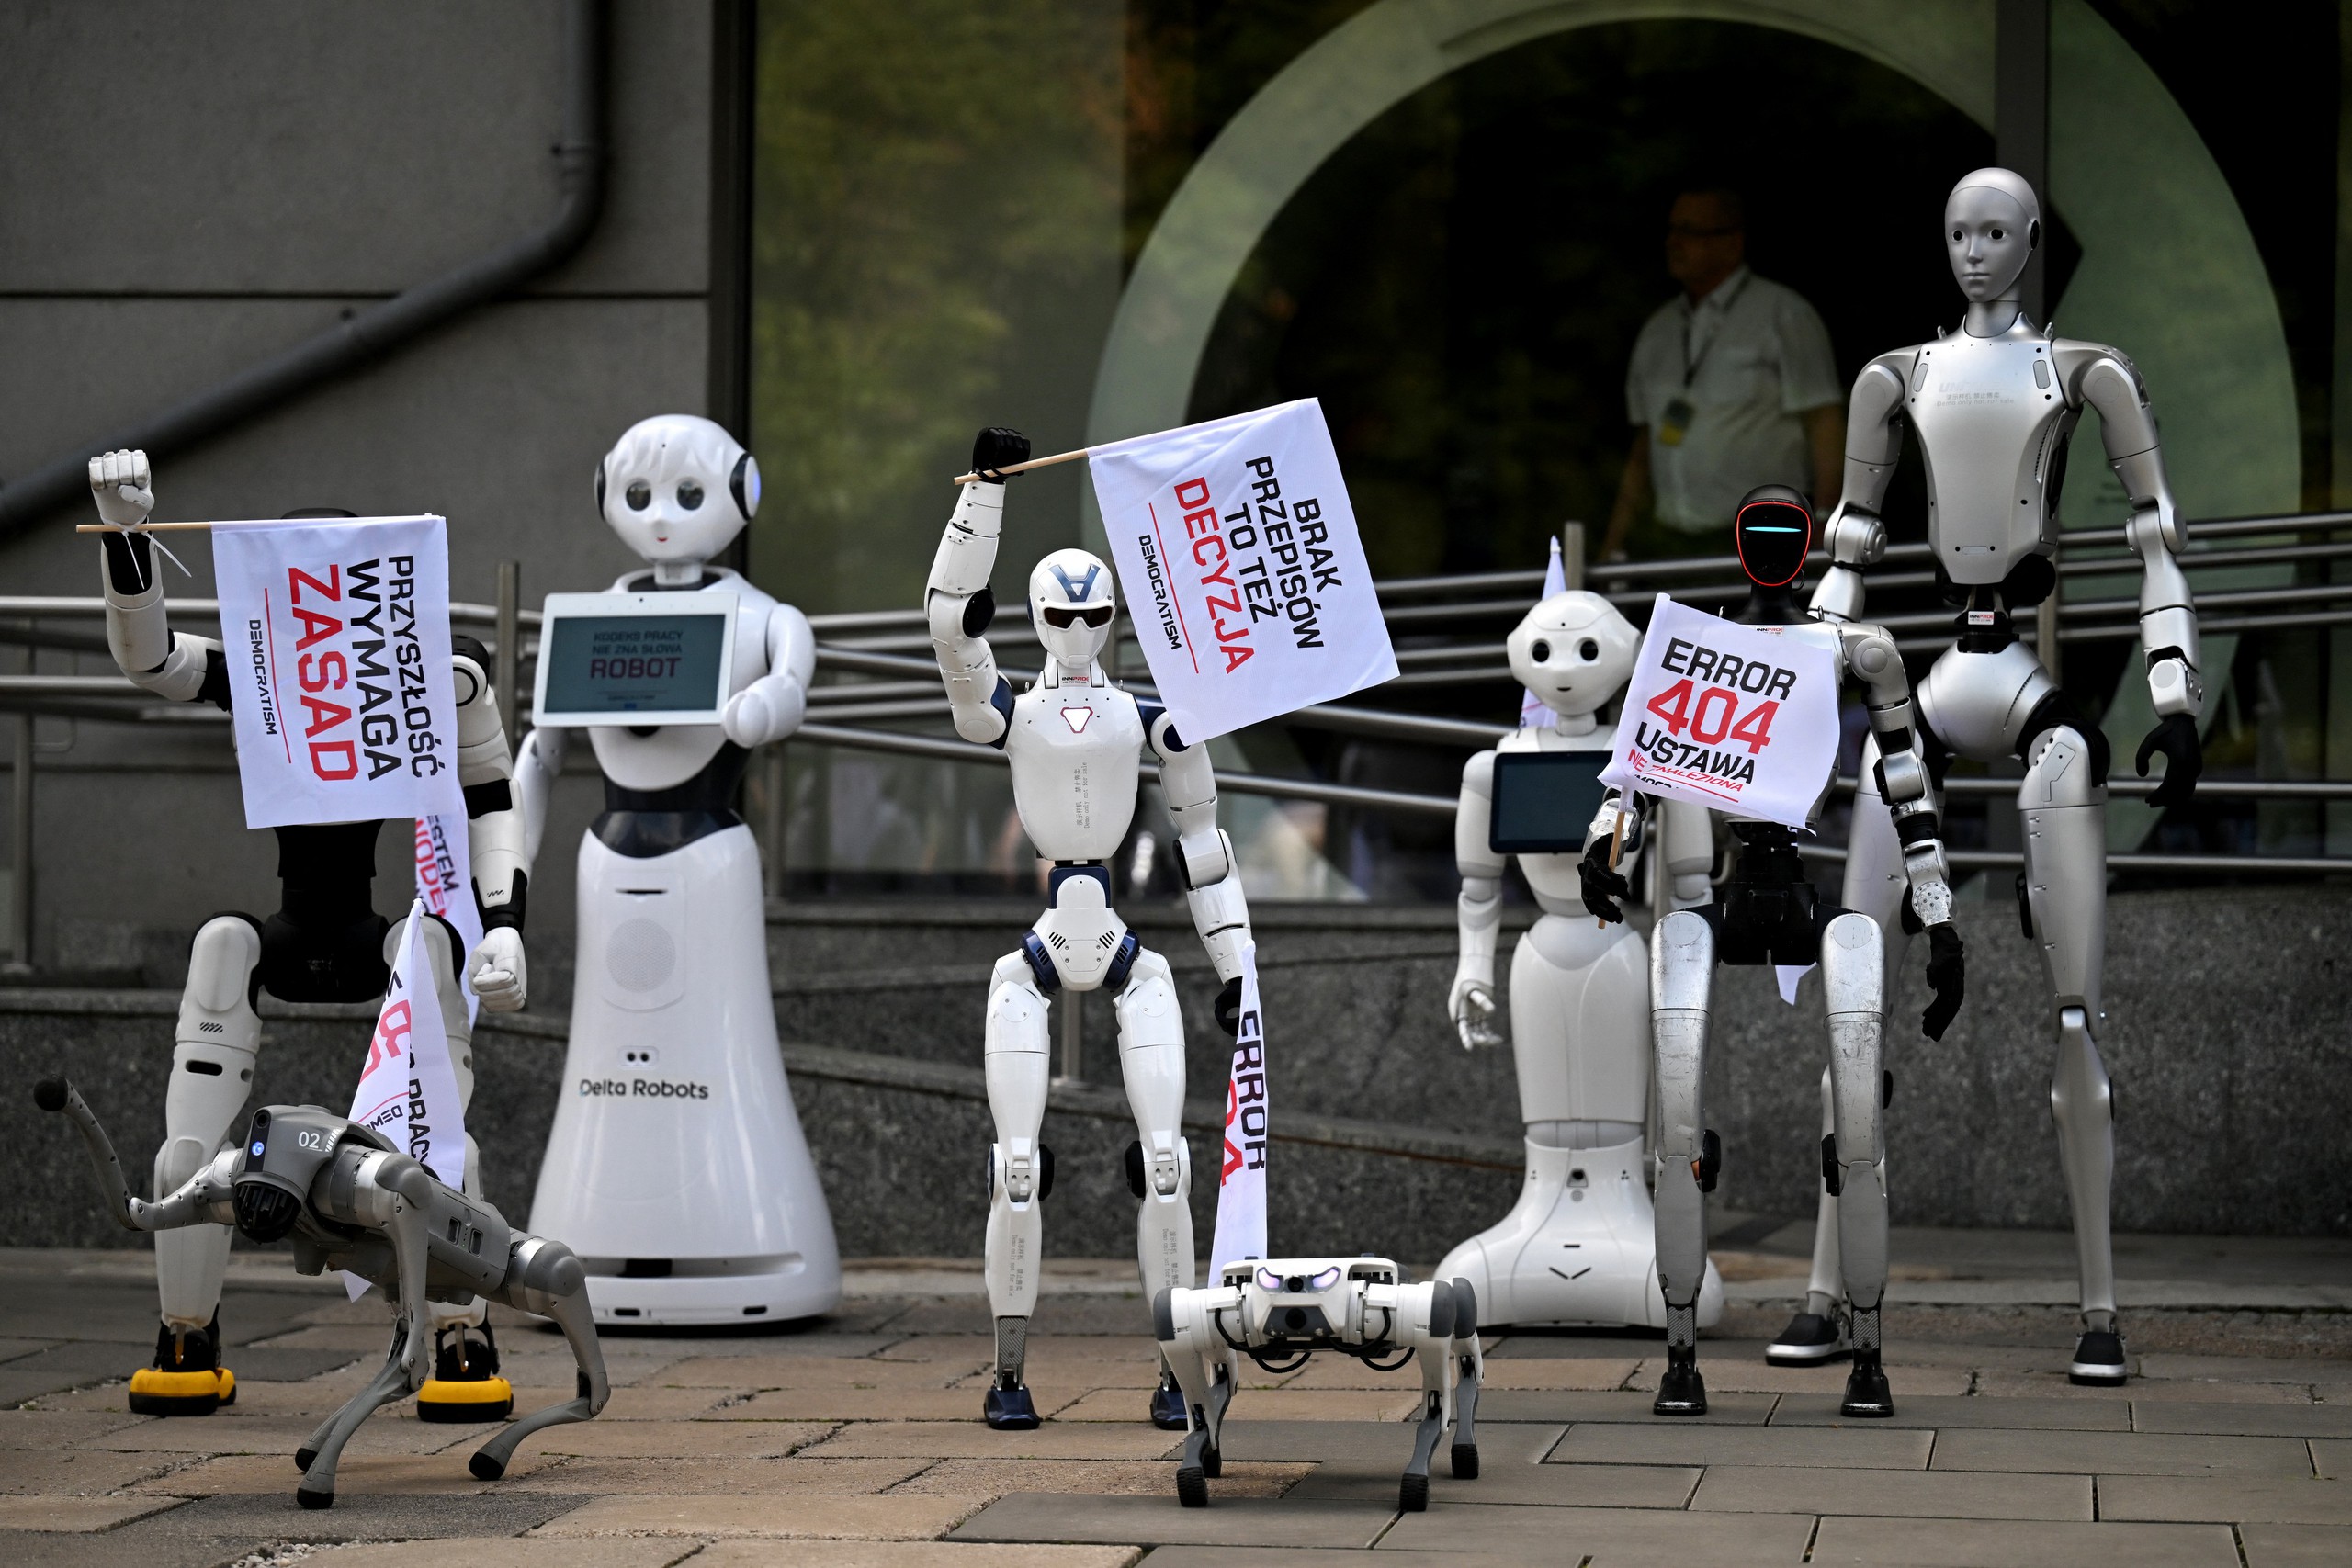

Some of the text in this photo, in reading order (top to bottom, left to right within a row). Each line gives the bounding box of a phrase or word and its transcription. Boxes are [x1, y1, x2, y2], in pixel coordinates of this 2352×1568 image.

[1138, 534, 1182, 650] DEMOCRATISM
[1173, 477, 1255, 674] DECYZJA
[1225, 502, 1283, 624] TO TEŻ
[1245, 456, 1325, 649] PRZEPISÓW
[1293, 498, 1342, 593] BRAK
[249, 619, 277, 735] DEMOCRATISM
[288, 564, 359, 781] ZASAD
[346, 558, 402, 781] WYMAGA
[389, 556, 446, 778] PRZYSZŁOŚĆ
[590, 657, 683, 679] ROBOT
[594, 630, 684, 642] KODEKS PRACY
[1661, 637, 1797, 700] ERROR
[1635, 722, 1756, 784] USTAWA
[1646, 679, 1780, 755] 404
[426, 815, 460, 892] ESTEM
[580, 1078, 709, 1100] Delta Robots
[298, 1131, 320, 1149] 02
